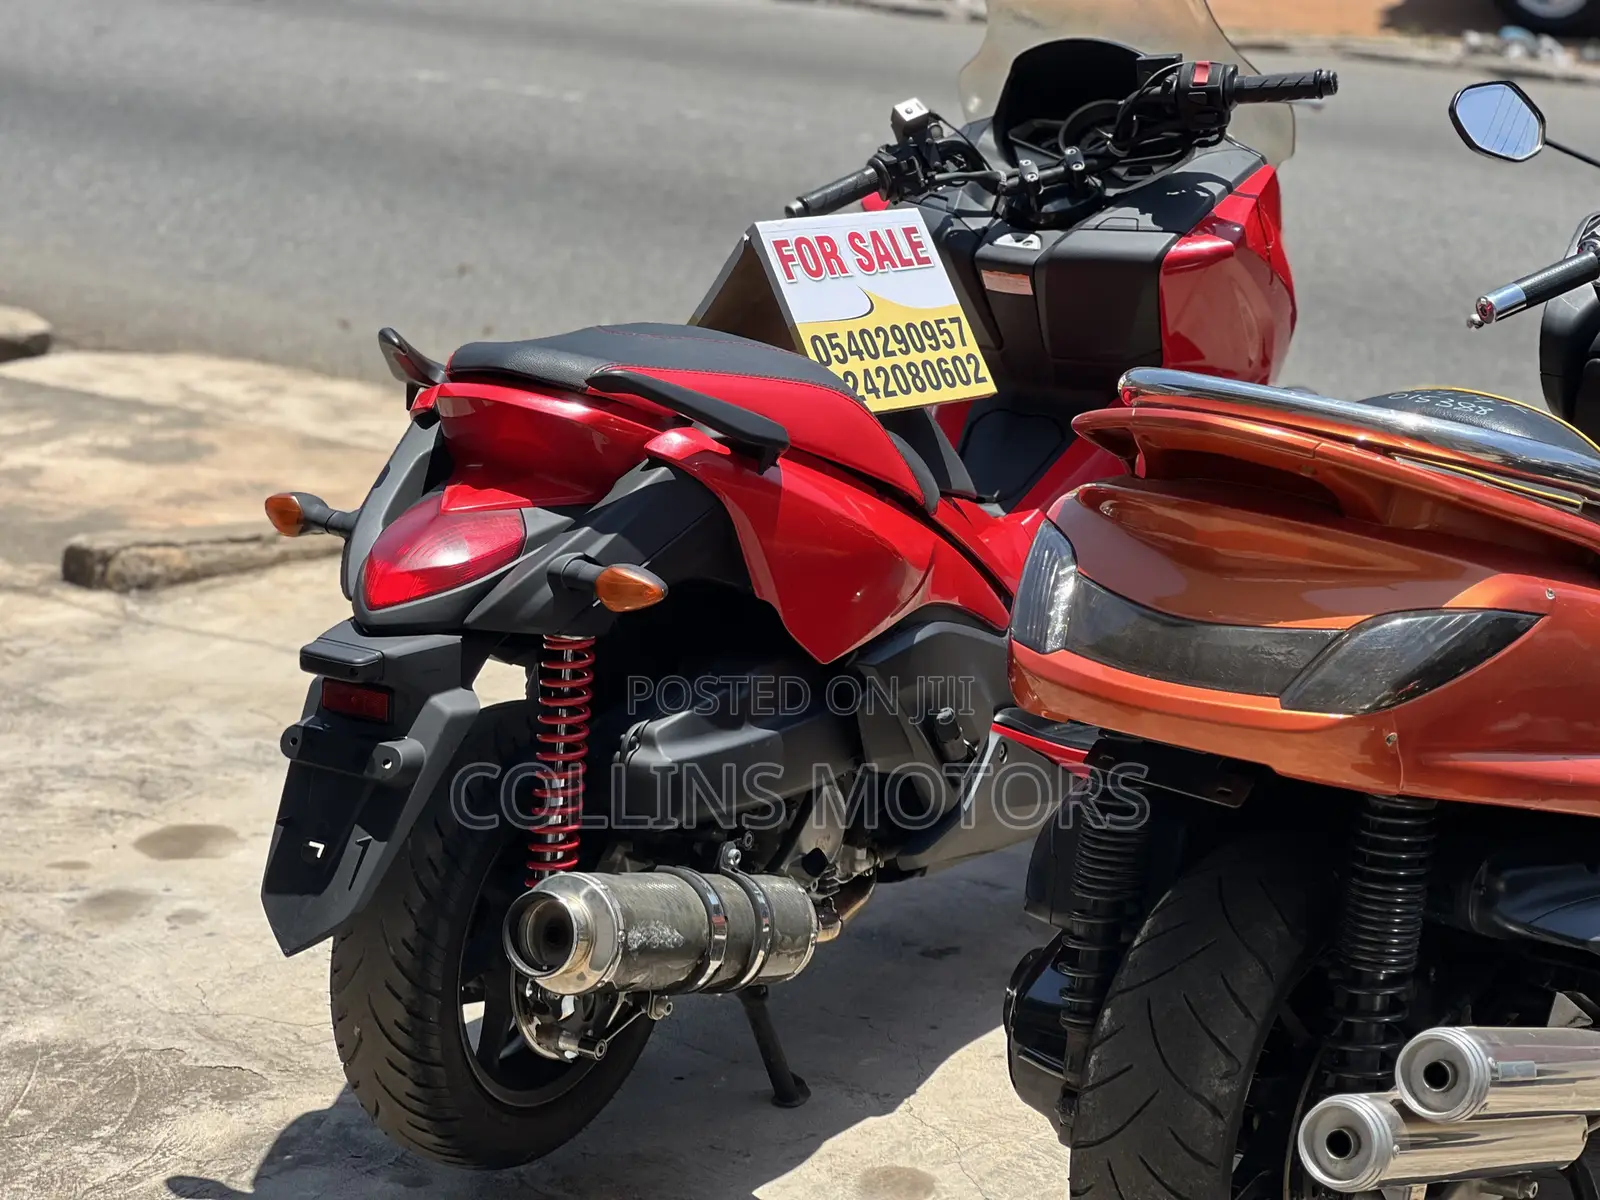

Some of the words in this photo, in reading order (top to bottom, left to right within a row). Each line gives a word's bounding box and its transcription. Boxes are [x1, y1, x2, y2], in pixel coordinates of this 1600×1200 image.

[771, 234, 850, 283] FOR
[847, 225, 933, 275] SALE
[810, 316, 967, 367] 0540290957
[843, 354, 987, 401] 242080602
